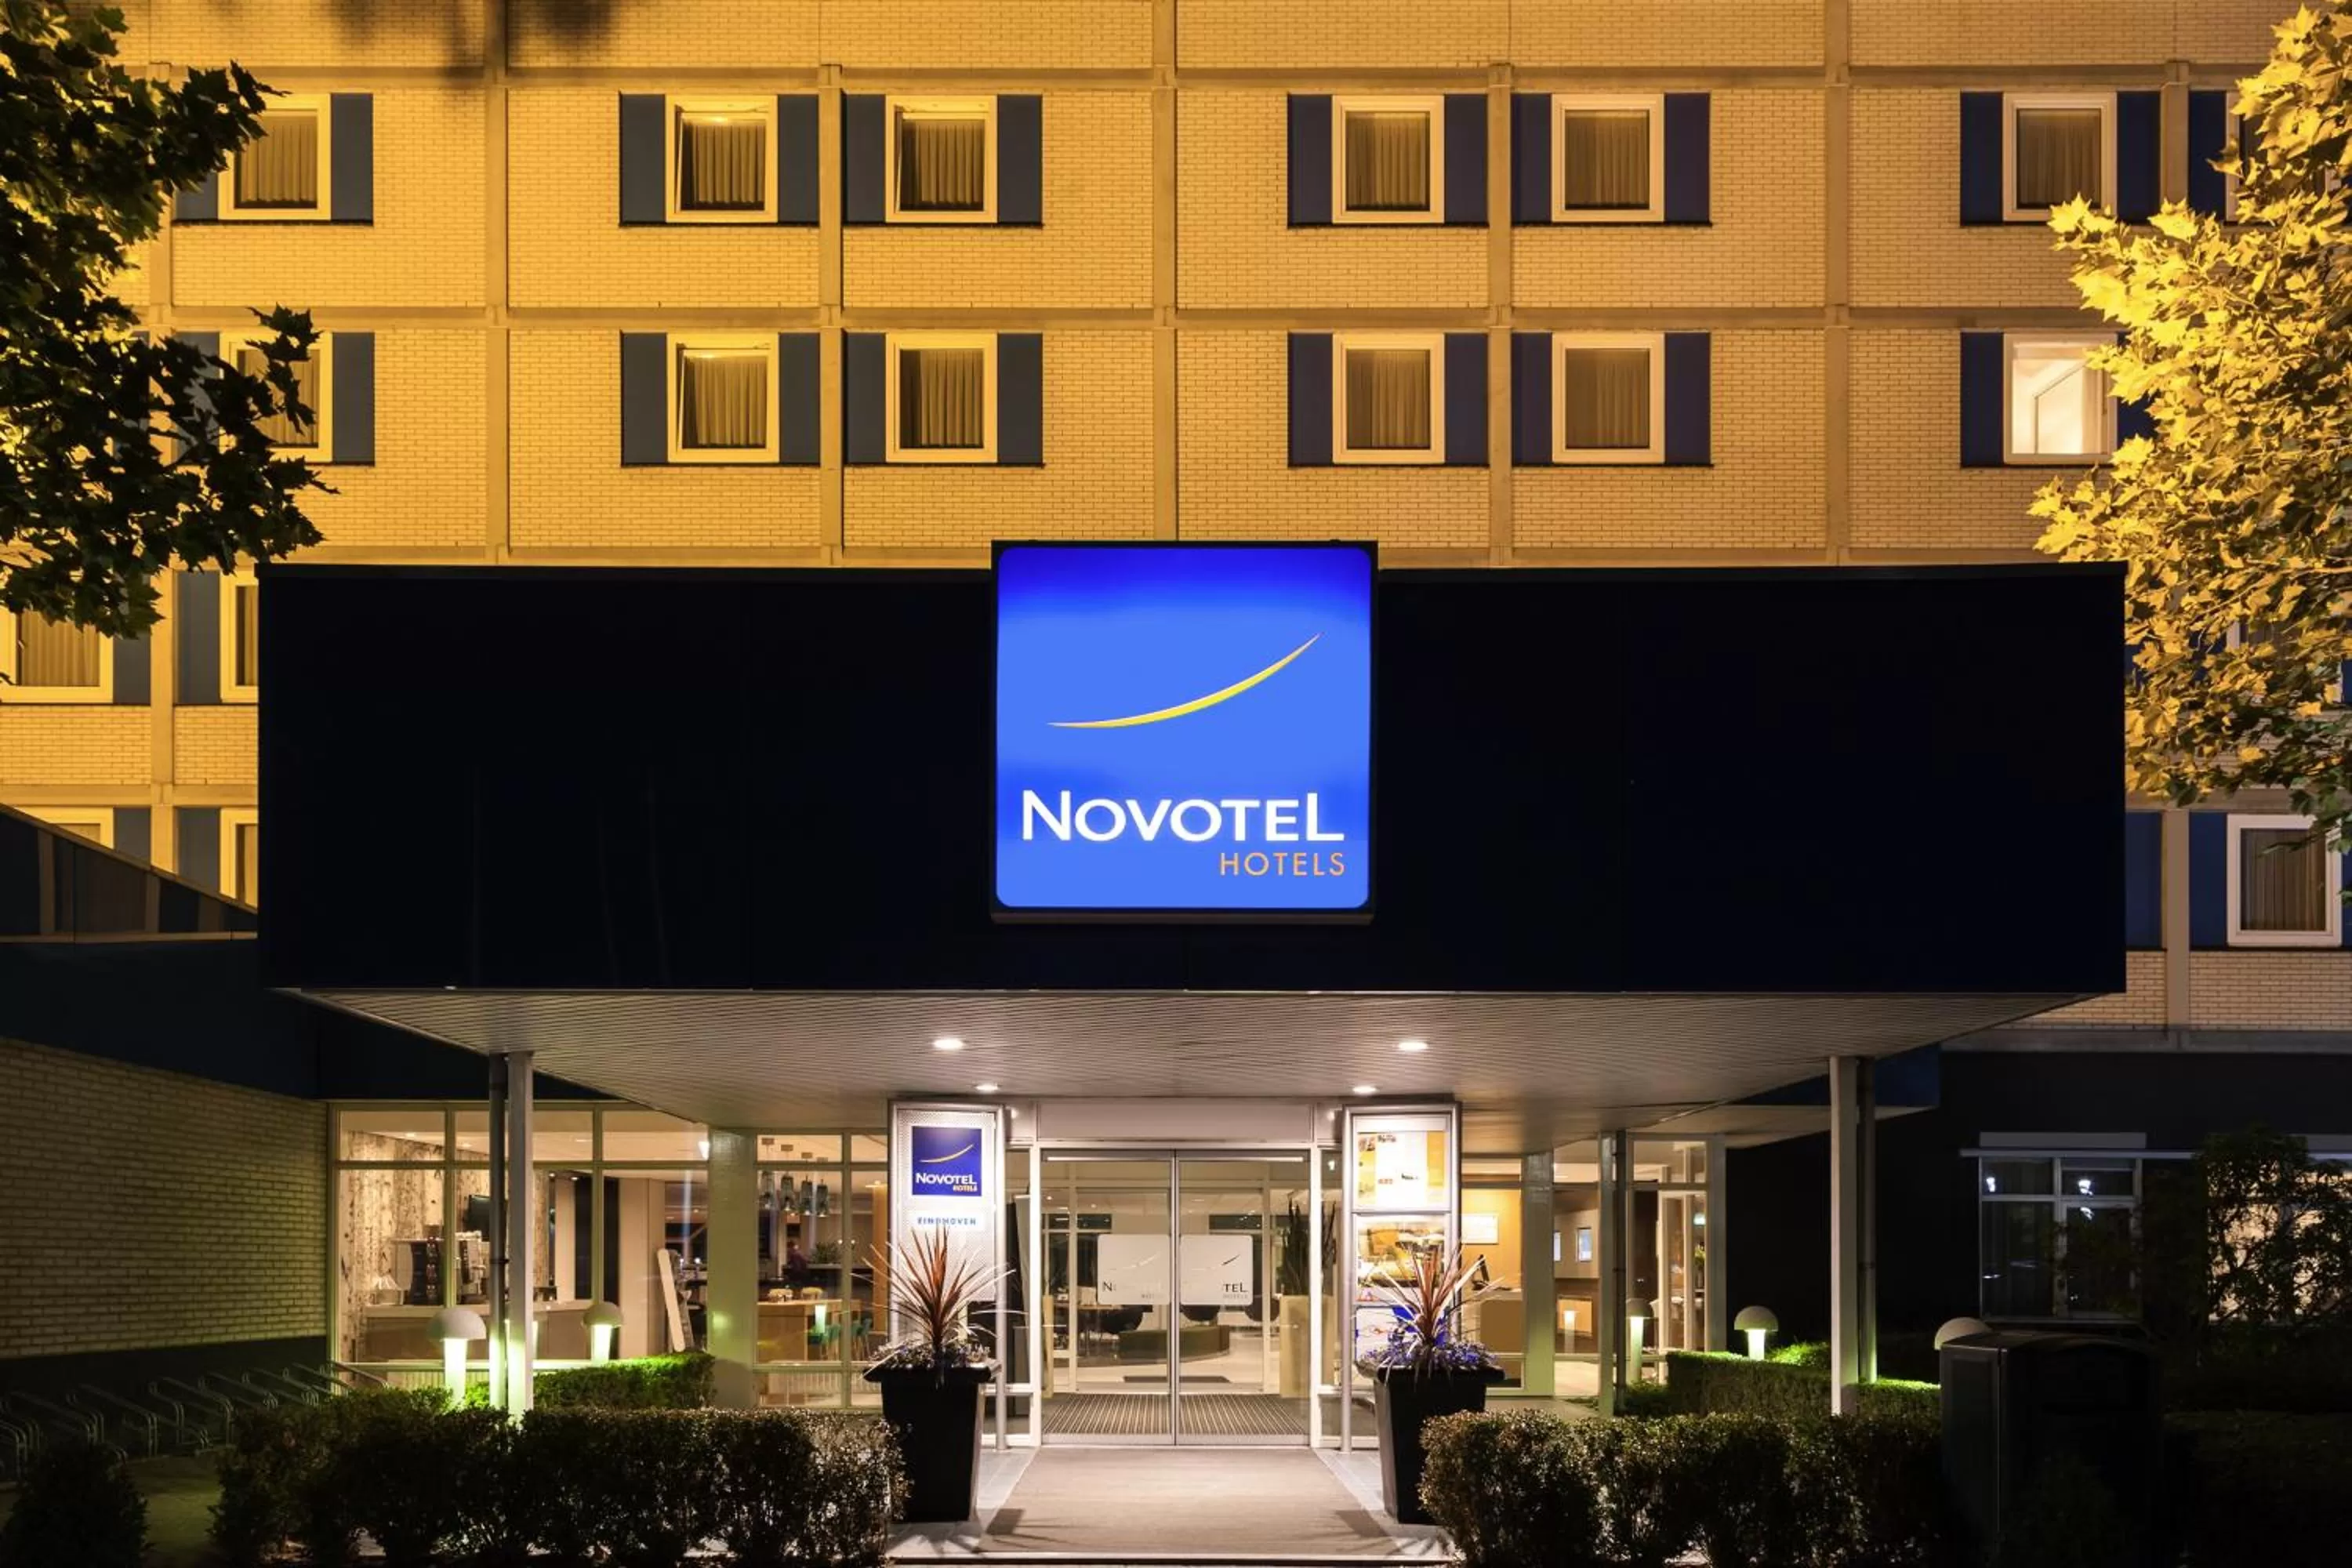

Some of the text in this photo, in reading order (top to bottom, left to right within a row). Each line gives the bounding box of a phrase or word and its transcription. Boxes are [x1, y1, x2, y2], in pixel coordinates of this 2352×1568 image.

[1022, 789, 1345, 841] NOVOTEL
[1220, 852, 1345, 877] HOTELS
[916, 1173, 977, 1185] NOVOTEL
